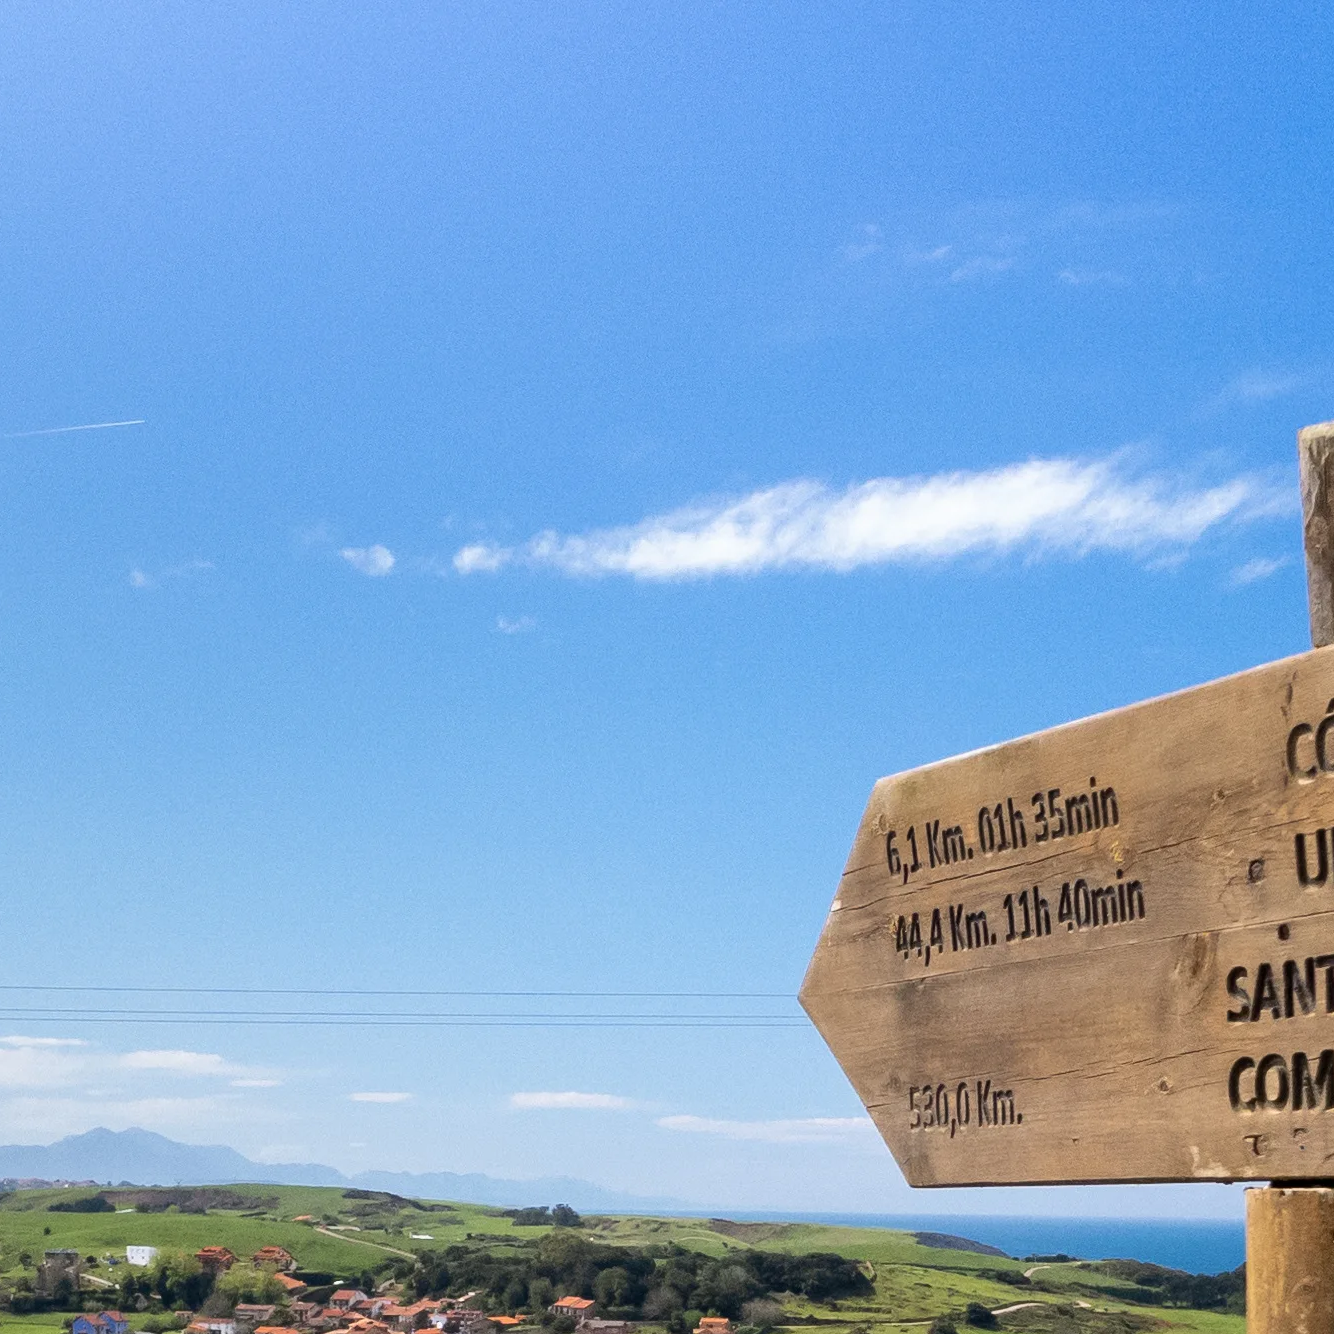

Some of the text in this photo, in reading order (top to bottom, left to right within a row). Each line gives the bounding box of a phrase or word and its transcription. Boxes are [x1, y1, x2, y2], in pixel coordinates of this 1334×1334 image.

[887, 776, 1120, 884] 6,1 Km. 01h 35min
[896, 869, 1146, 967] 44,4 Km. 11h 40min
[909, 1080, 1023, 1139] 530,0 Km.
